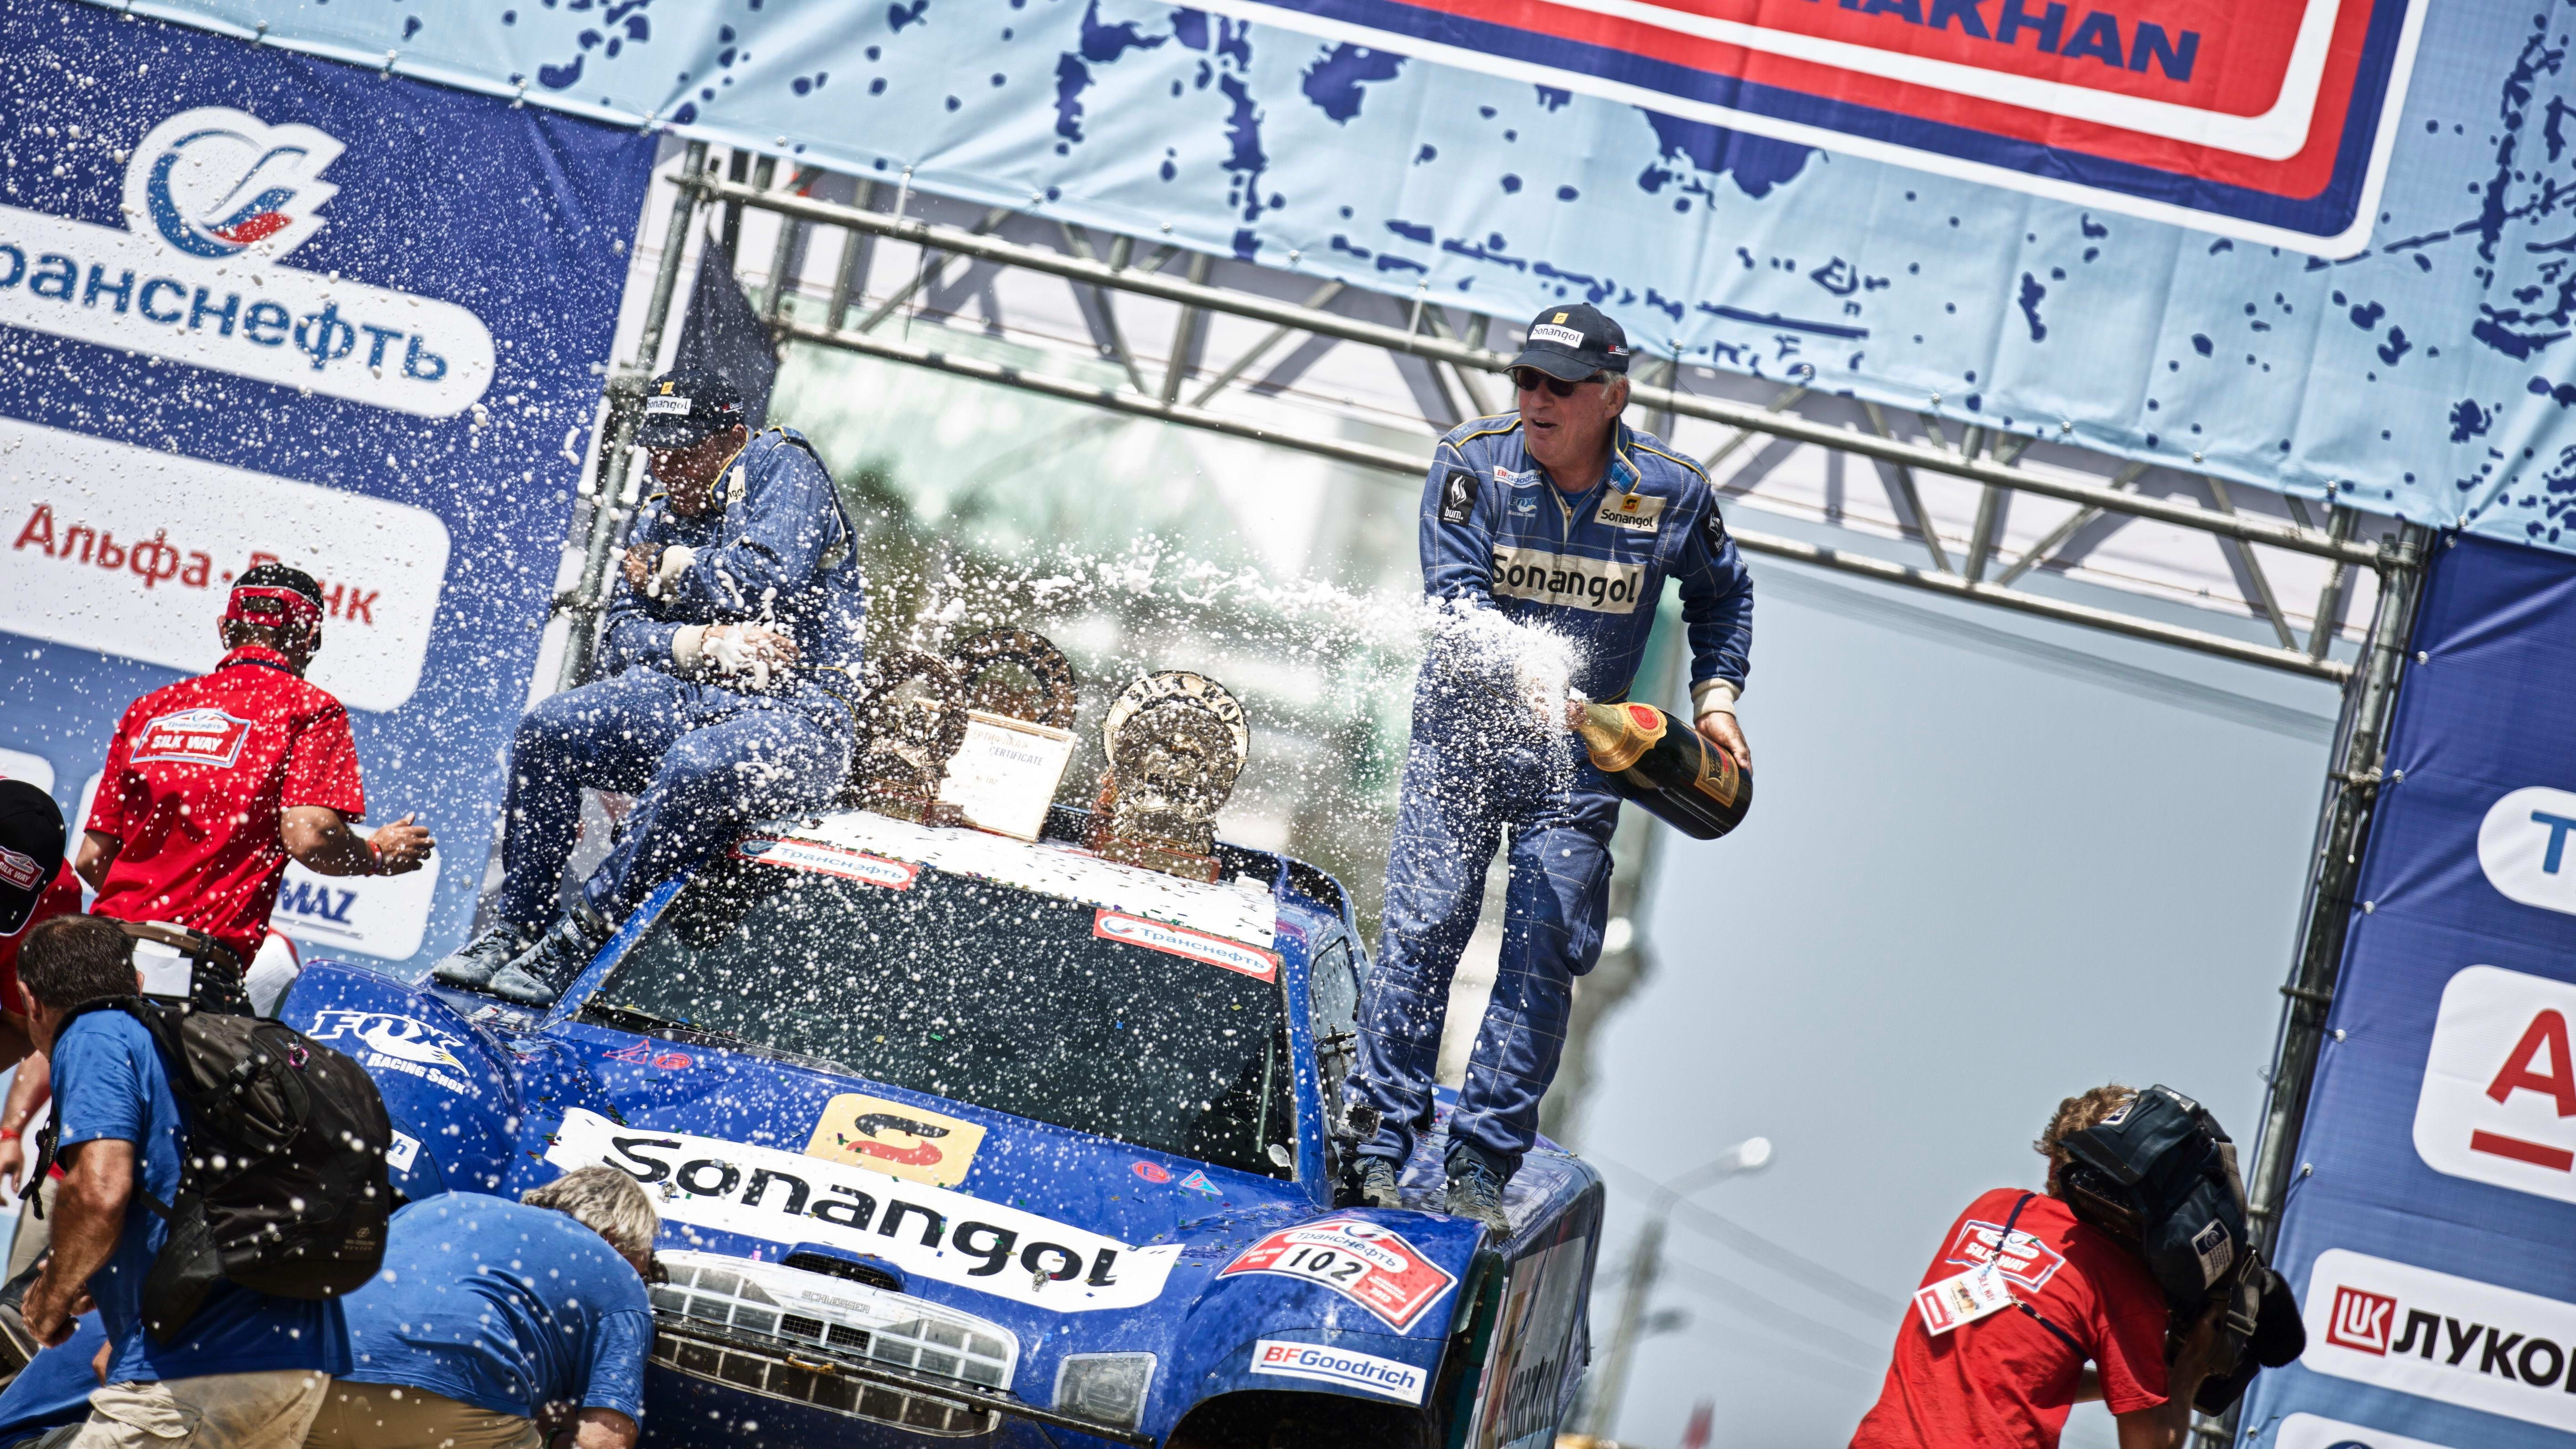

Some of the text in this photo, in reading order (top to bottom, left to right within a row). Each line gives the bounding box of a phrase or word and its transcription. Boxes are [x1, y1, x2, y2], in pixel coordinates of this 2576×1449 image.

[1533, 326, 1580, 342] Sonangol
[646, 398, 687, 411] Sonangol
[1509, 496, 1537, 510] FOX
[1600, 508, 1653, 528] Sonangol
[1493, 553, 1638, 607] Sonangol
[151, 735, 224, 752] SILK WAY
[989, 746, 1044, 766] CERTIFICATE
[780, 847, 902, 879] Транснефть
[13, 871, 31, 883] WAY
[564, 922, 581, 940] OMP
[1140, 928, 1265, 969] Транснефть
[305, 1010, 466, 1061] FOX
[367, 1052, 428, 1078] RACING
[603, 1135, 1119, 1288] Sonangol
[1296, 1231, 1397, 1267] Транснефть
[1983, 1233, 2033, 1256] Траснефть
[1289, 1248, 1363, 1282] 102
[1997, 1254, 2031, 1271] WAY
[801, 1290, 871, 1314] SCHLESSER
[1263, 1345, 1416, 1389] BFGoodrich
